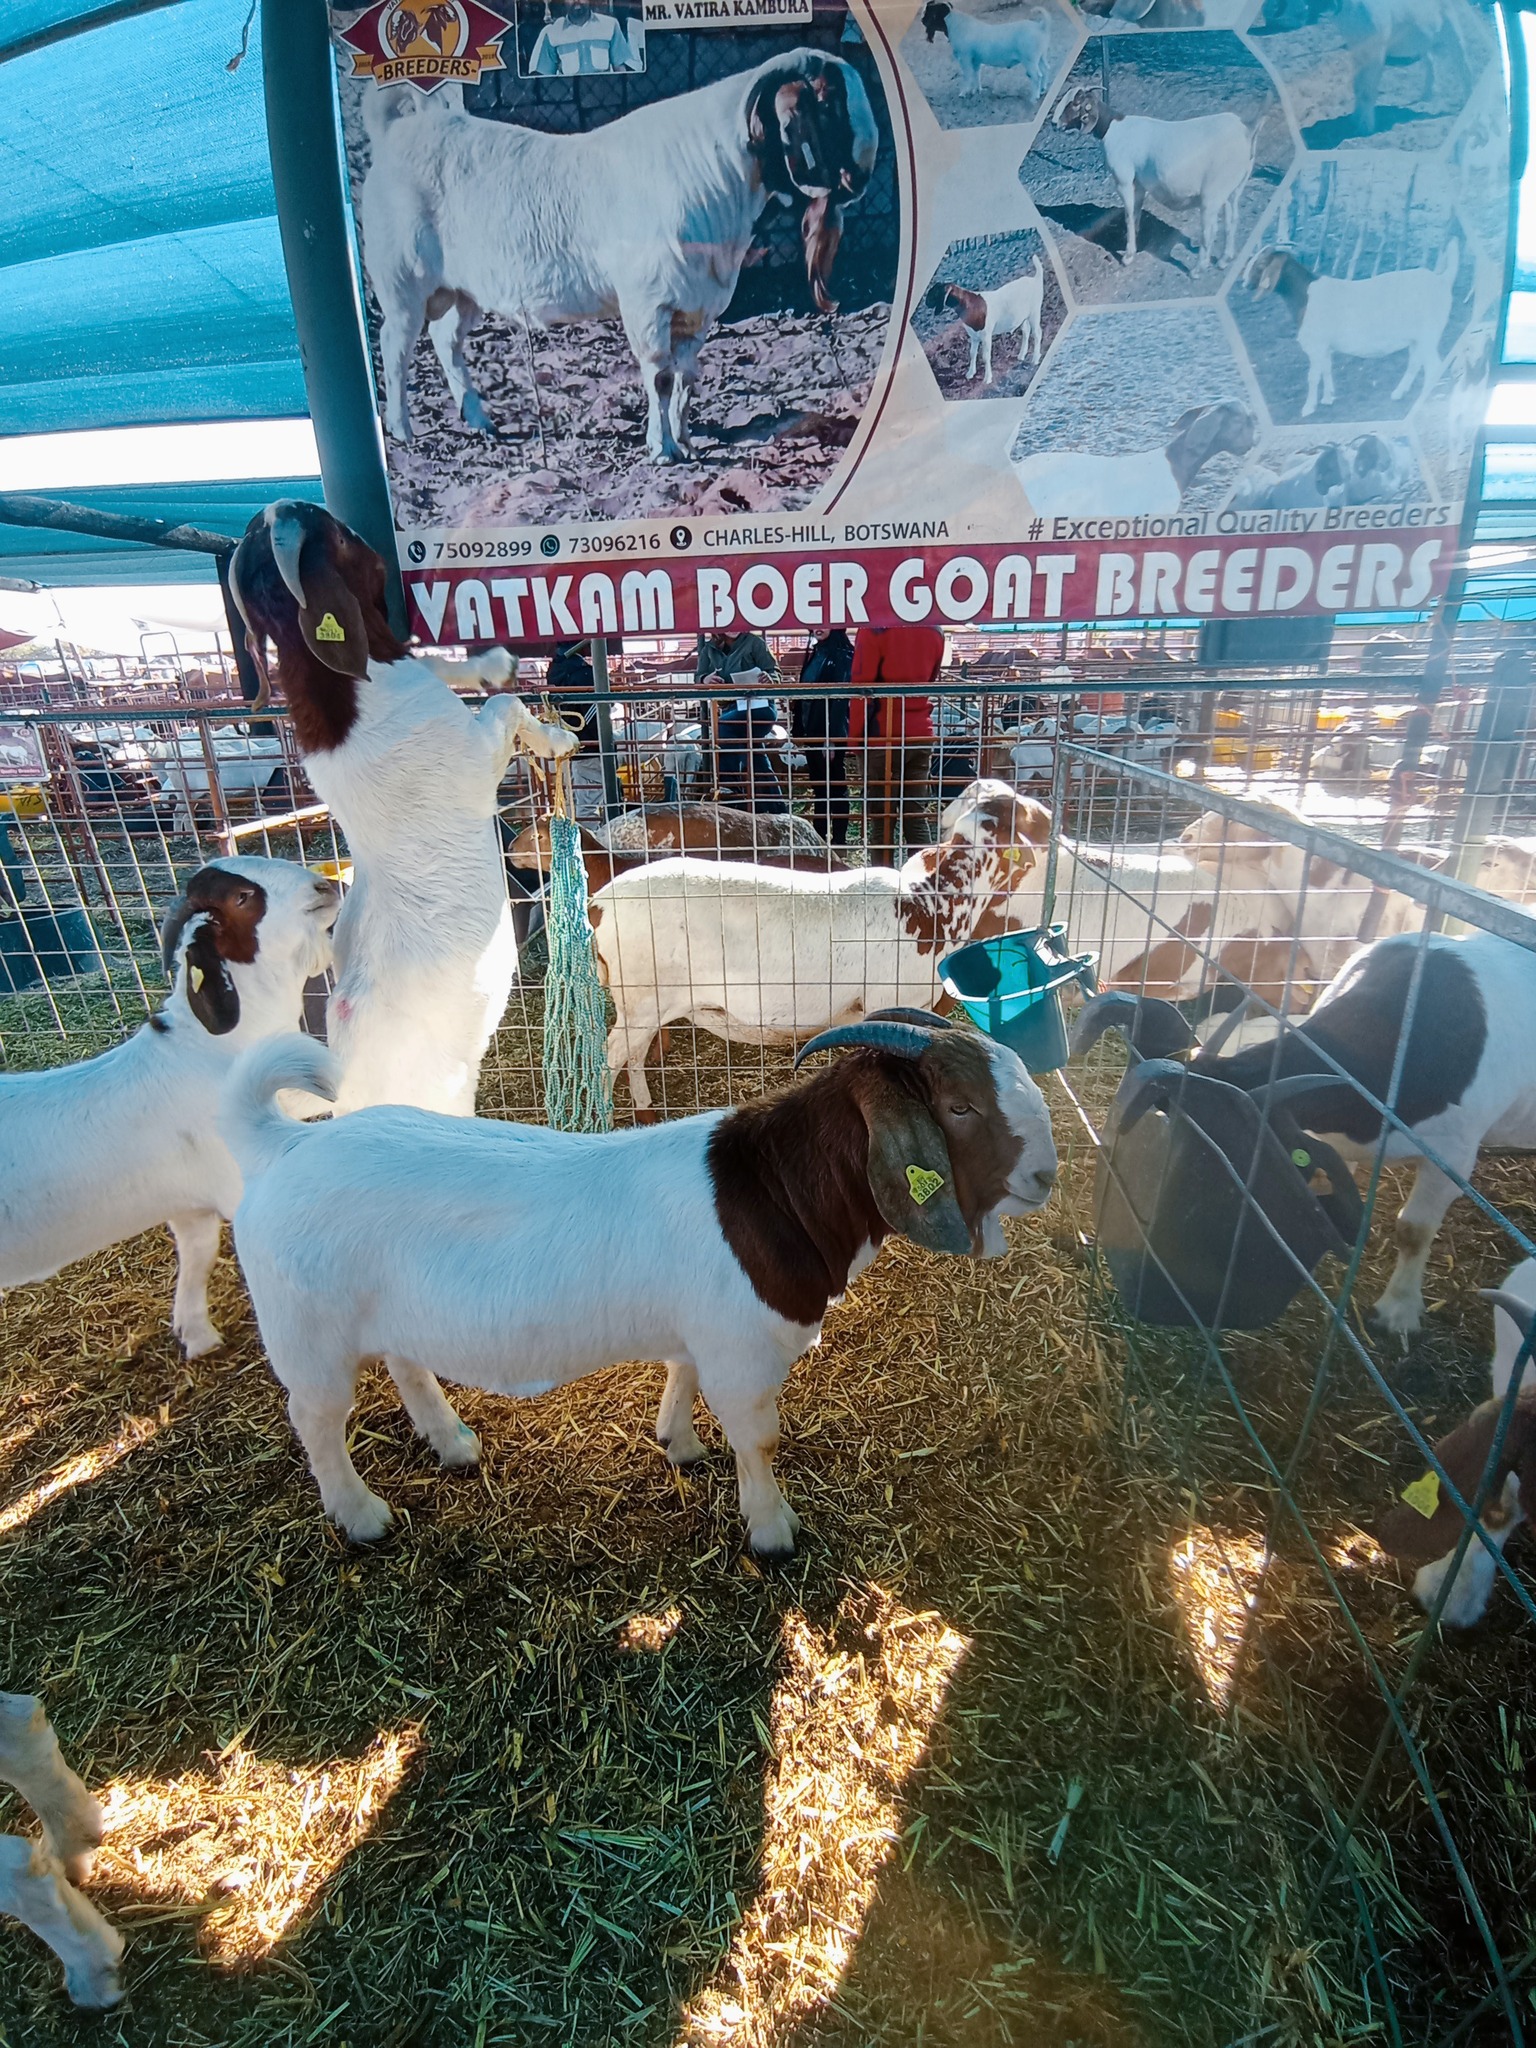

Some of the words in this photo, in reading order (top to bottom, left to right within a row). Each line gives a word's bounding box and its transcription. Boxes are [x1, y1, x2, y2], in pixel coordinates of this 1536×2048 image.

[645, 4, 672, 21] MR.
[674, 1, 730, 19] VATIRA
[433, 540, 532, 559] 75092899
[568, 534, 661, 554] 73096216
[703, 522, 836, 548] CHARLES-HILL,
[844, 520, 949, 541] BOTSWANA
[1052, 511, 1209, 540] Exceptional
[1216, 509, 1318, 533] Quality
[1323, 504, 1451, 530] Breeders
[410, 568, 675, 643] VATKAM
[696, 562, 869, 629] BOER
[889, 555, 1077, 624] GOAT
[1094, 539, 1444, 618] BREEDERS
[917, 1178, 942, 1201] 3802
